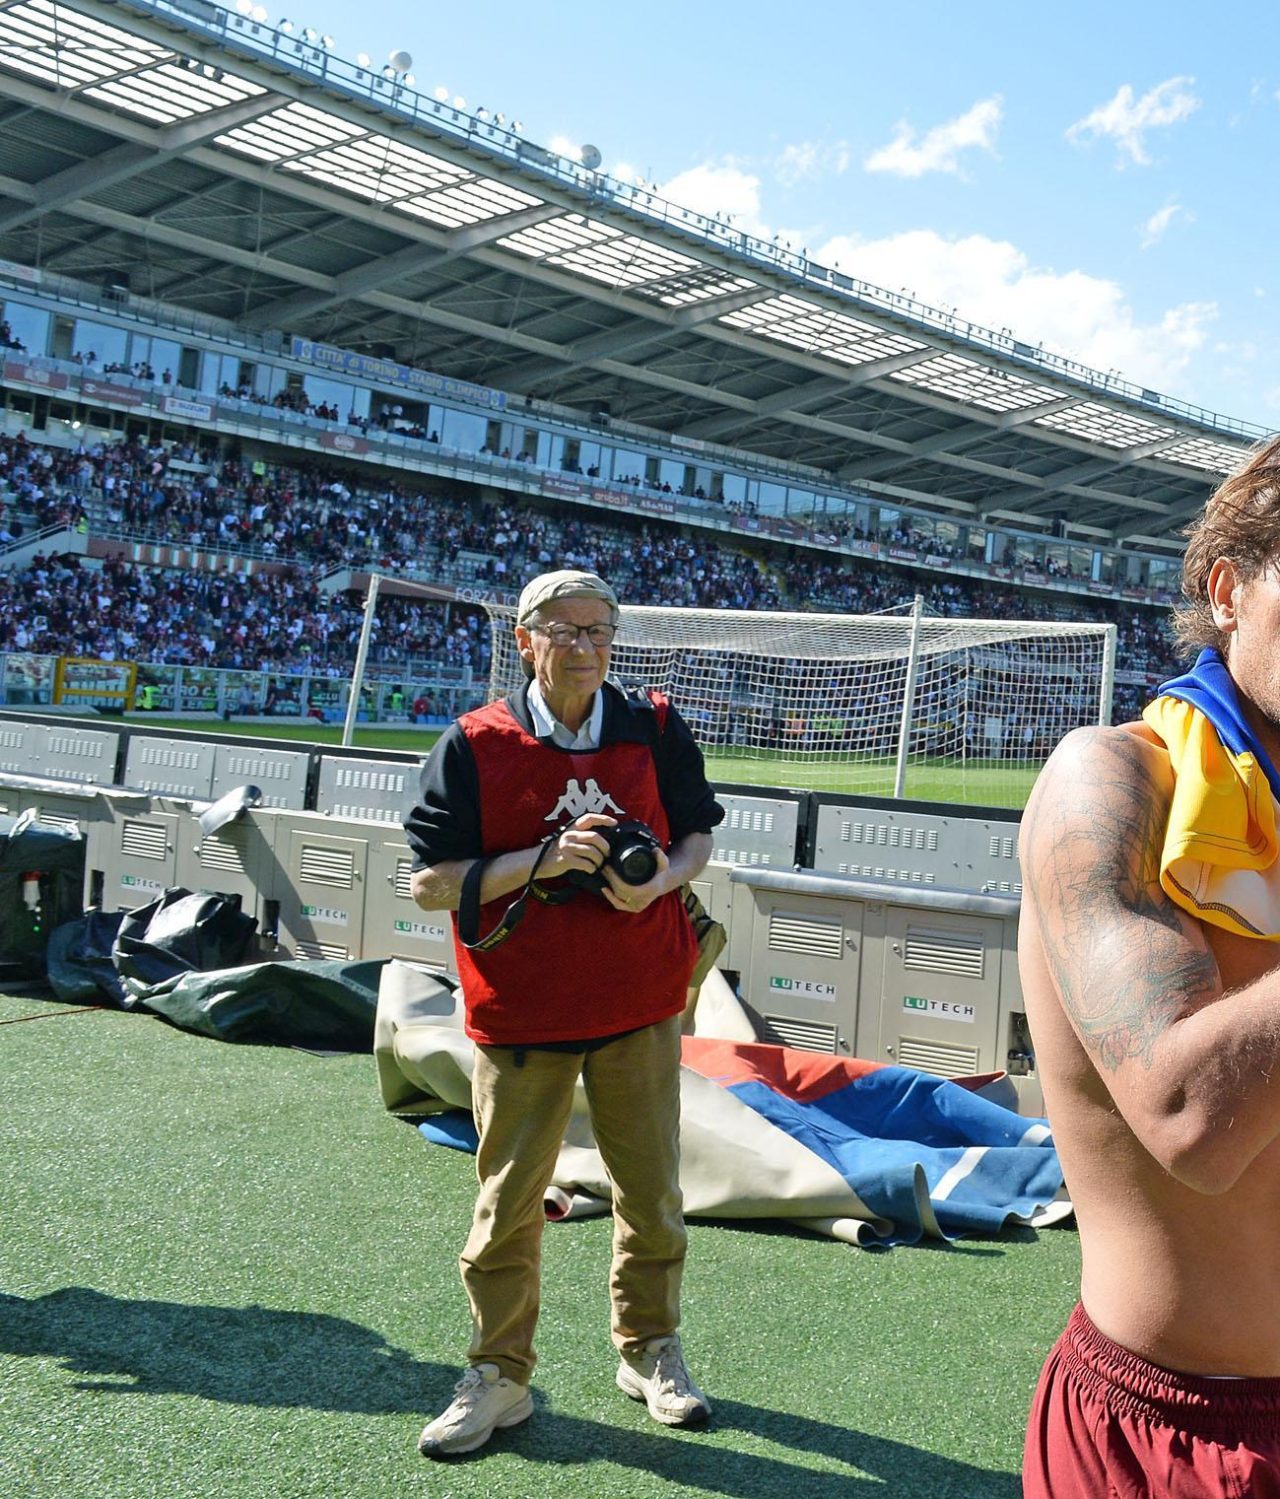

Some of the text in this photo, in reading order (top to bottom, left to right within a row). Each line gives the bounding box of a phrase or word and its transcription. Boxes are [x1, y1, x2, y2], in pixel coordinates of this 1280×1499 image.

[456, 588, 498, 605] FORZA
[396, 921, 444, 936] LUTECH
[771, 978, 835, 995] LUTECH
[905, 998, 973, 1015] LUTECH
